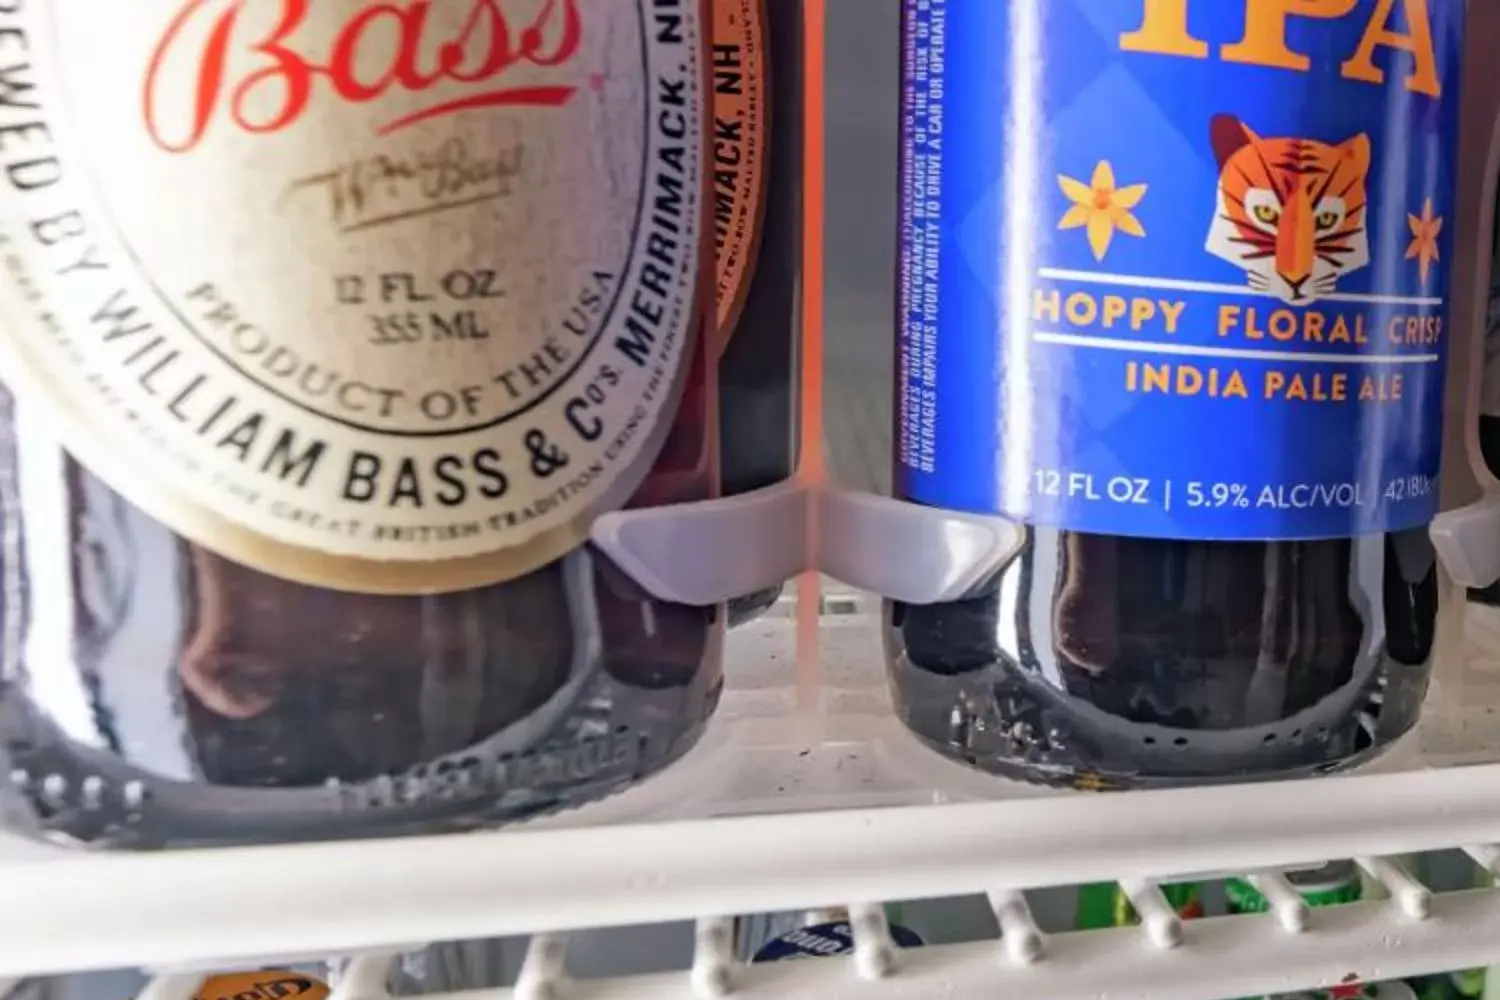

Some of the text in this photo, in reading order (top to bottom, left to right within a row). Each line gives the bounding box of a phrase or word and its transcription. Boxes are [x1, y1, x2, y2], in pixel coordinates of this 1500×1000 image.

[1118, 0, 1443, 97] IPA
[713, 43, 745, 261] IMACK, NH
[333, 269, 505, 304] 12 FL OZ
[184, 269, 616, 420] PRODUCT OF THE USA
[366, 309, 491, 345] 355 ML
[1032, 287, 1187, 336] HOPPY
[1217, 304, 1369, 346] FLORAL
[30, 209, 110, 275] BY
[91, 288, 328, 488] WILLIAM
[343, 447, 509, 508] BASS
[524, 428, 571, 478] &
[1125, 360, 1404, 402] INDIA PALE ALE
[1034, 469, 1060, 498] 12
[1068, 472, 1100, 500] FL
[1107, 477, 1150, 504] OZ
[1185, 482, 1250, 509] 5.9%
[1255, 482, 1365, 510] ALC/VOL
